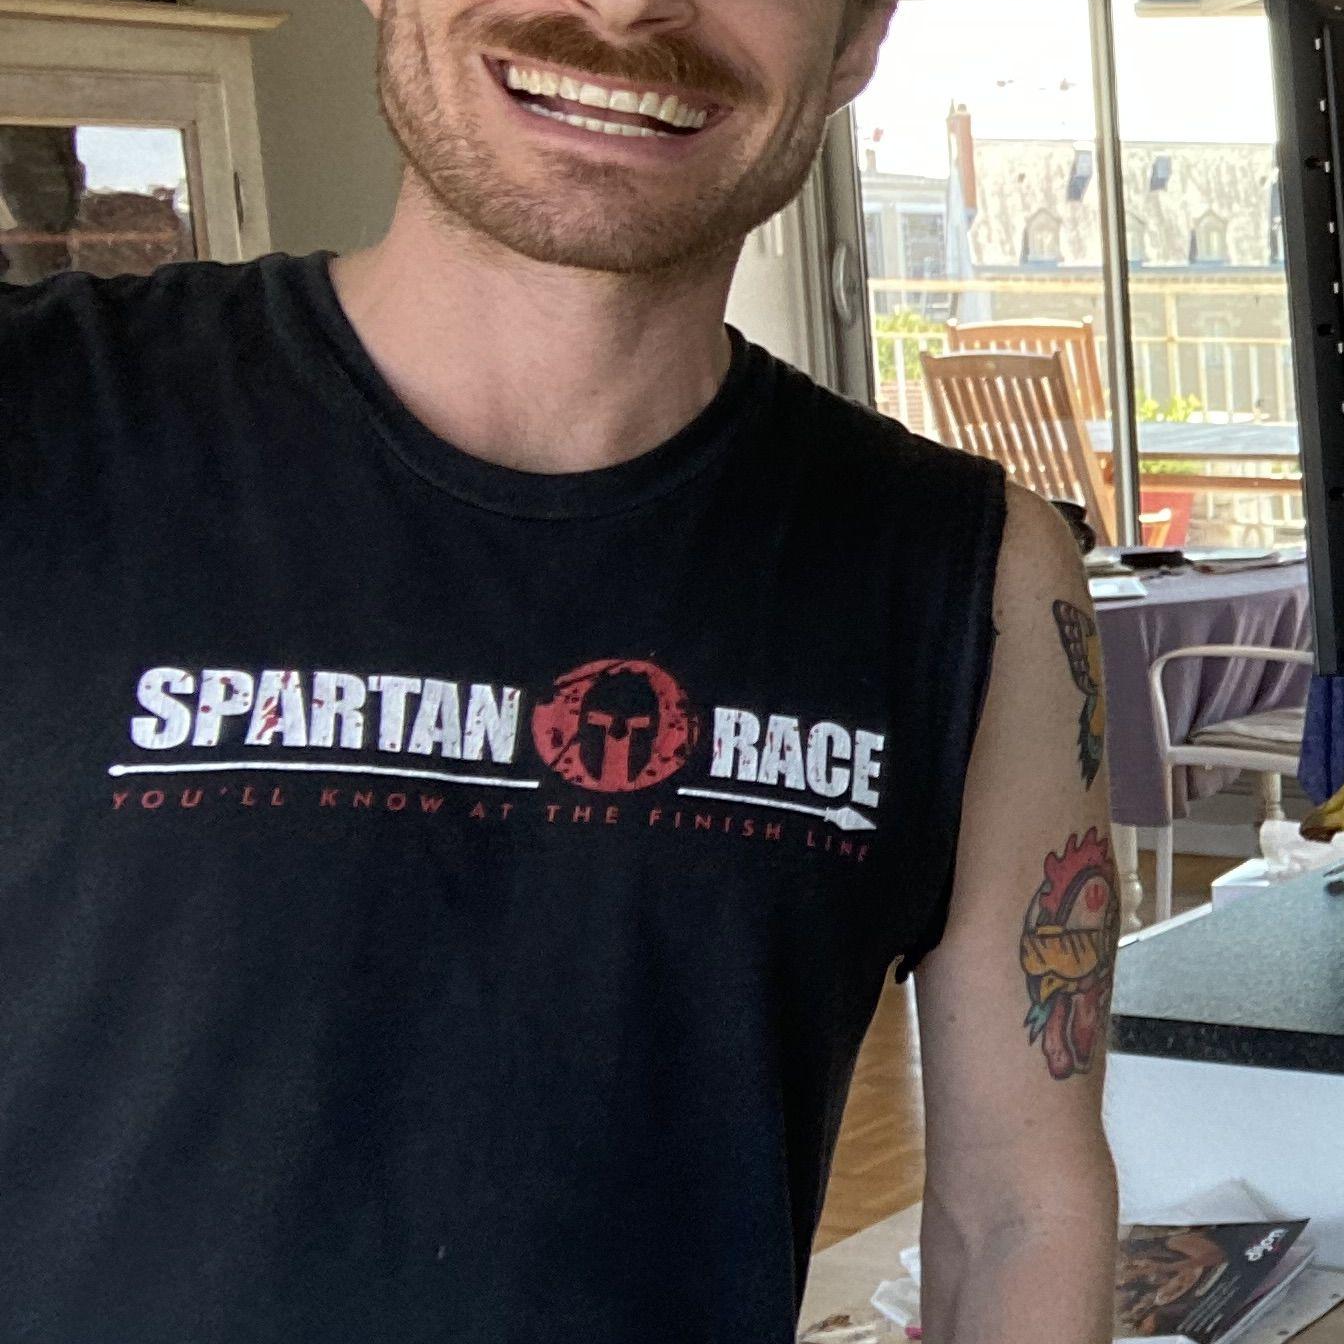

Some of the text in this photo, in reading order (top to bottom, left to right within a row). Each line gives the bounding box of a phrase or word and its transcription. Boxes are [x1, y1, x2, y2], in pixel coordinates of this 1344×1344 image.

[130, 667, 885, 808] SPARTAN RACE
[111, 785, 871, 863] YOU'LL KNOW AT THE FINISH LINE
